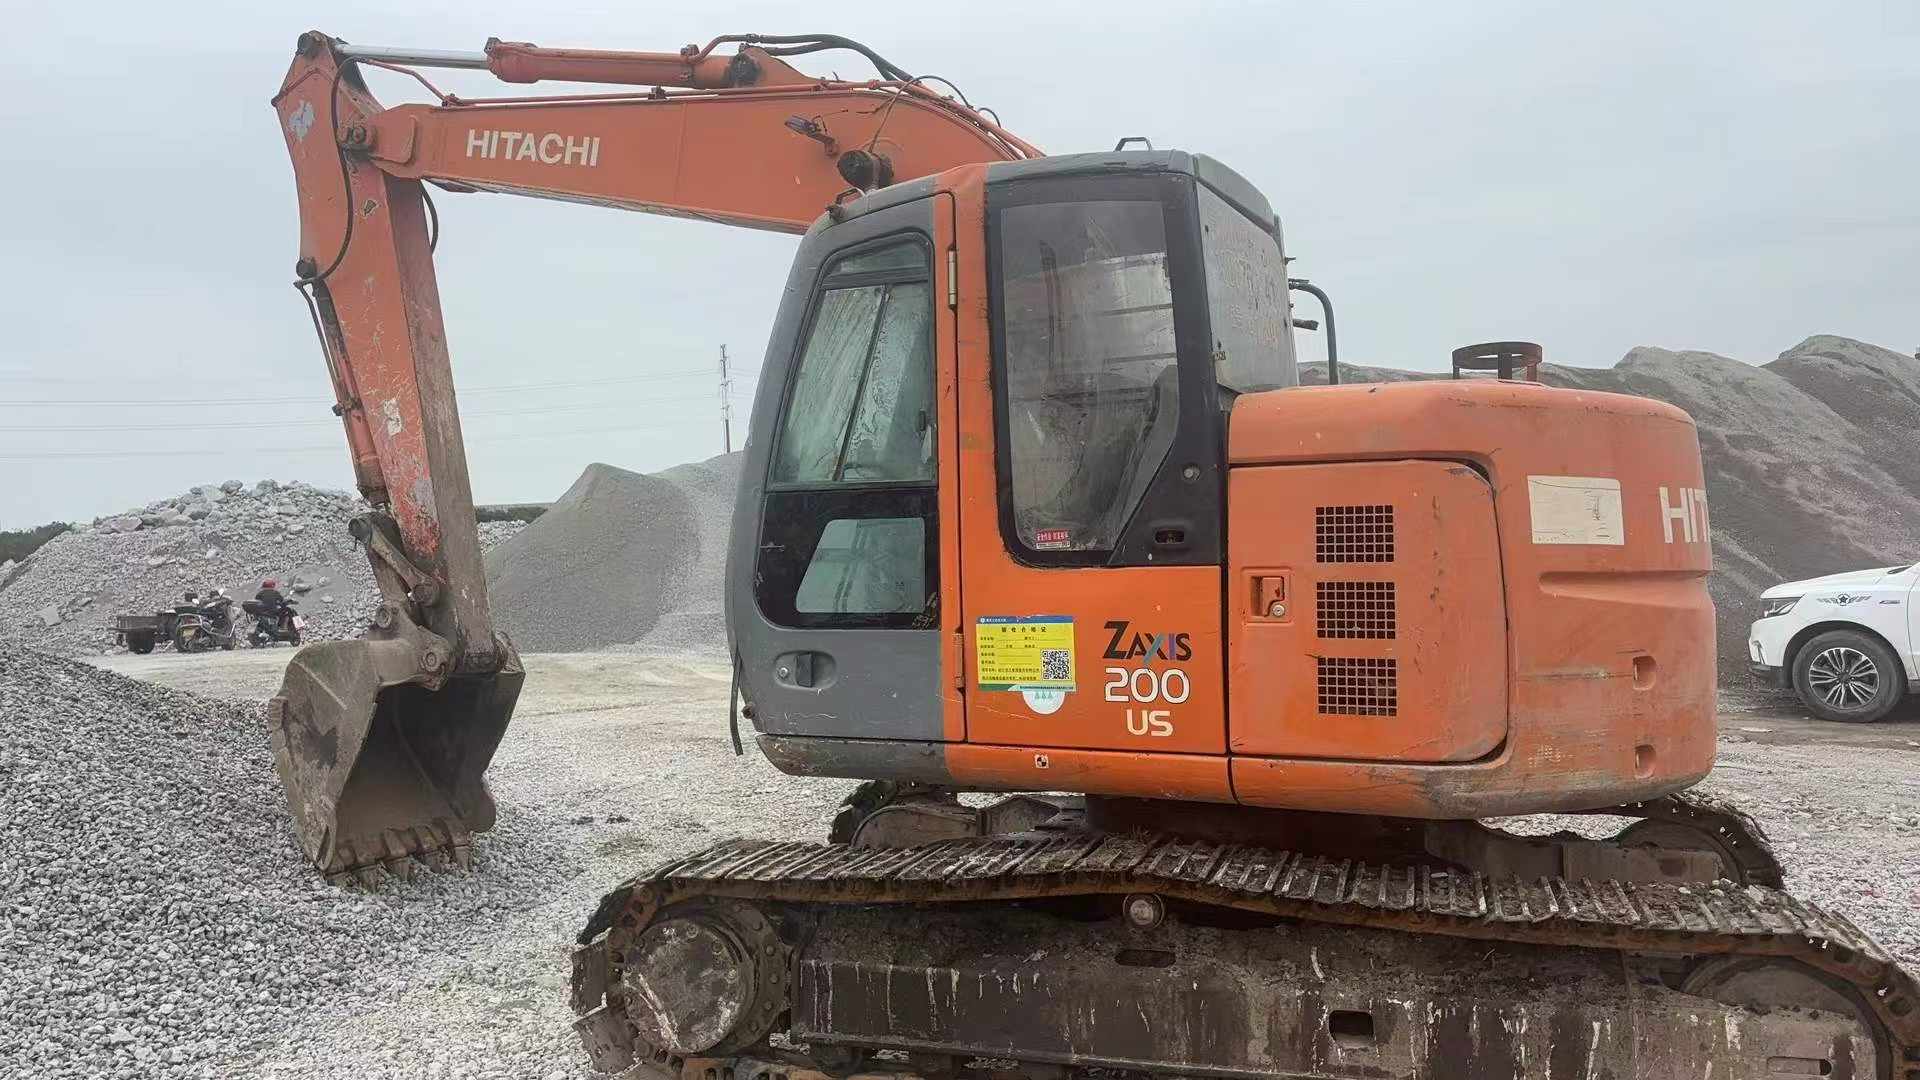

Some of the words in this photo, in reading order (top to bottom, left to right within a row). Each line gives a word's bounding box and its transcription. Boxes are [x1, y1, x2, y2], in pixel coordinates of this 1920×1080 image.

[466, 129, 600, 167] HITACHI
[1102, 621, 1192, 663] ZAXIS
[1105, 667, 1190, 704] 200
[1126, 709, 1174, 737] US
